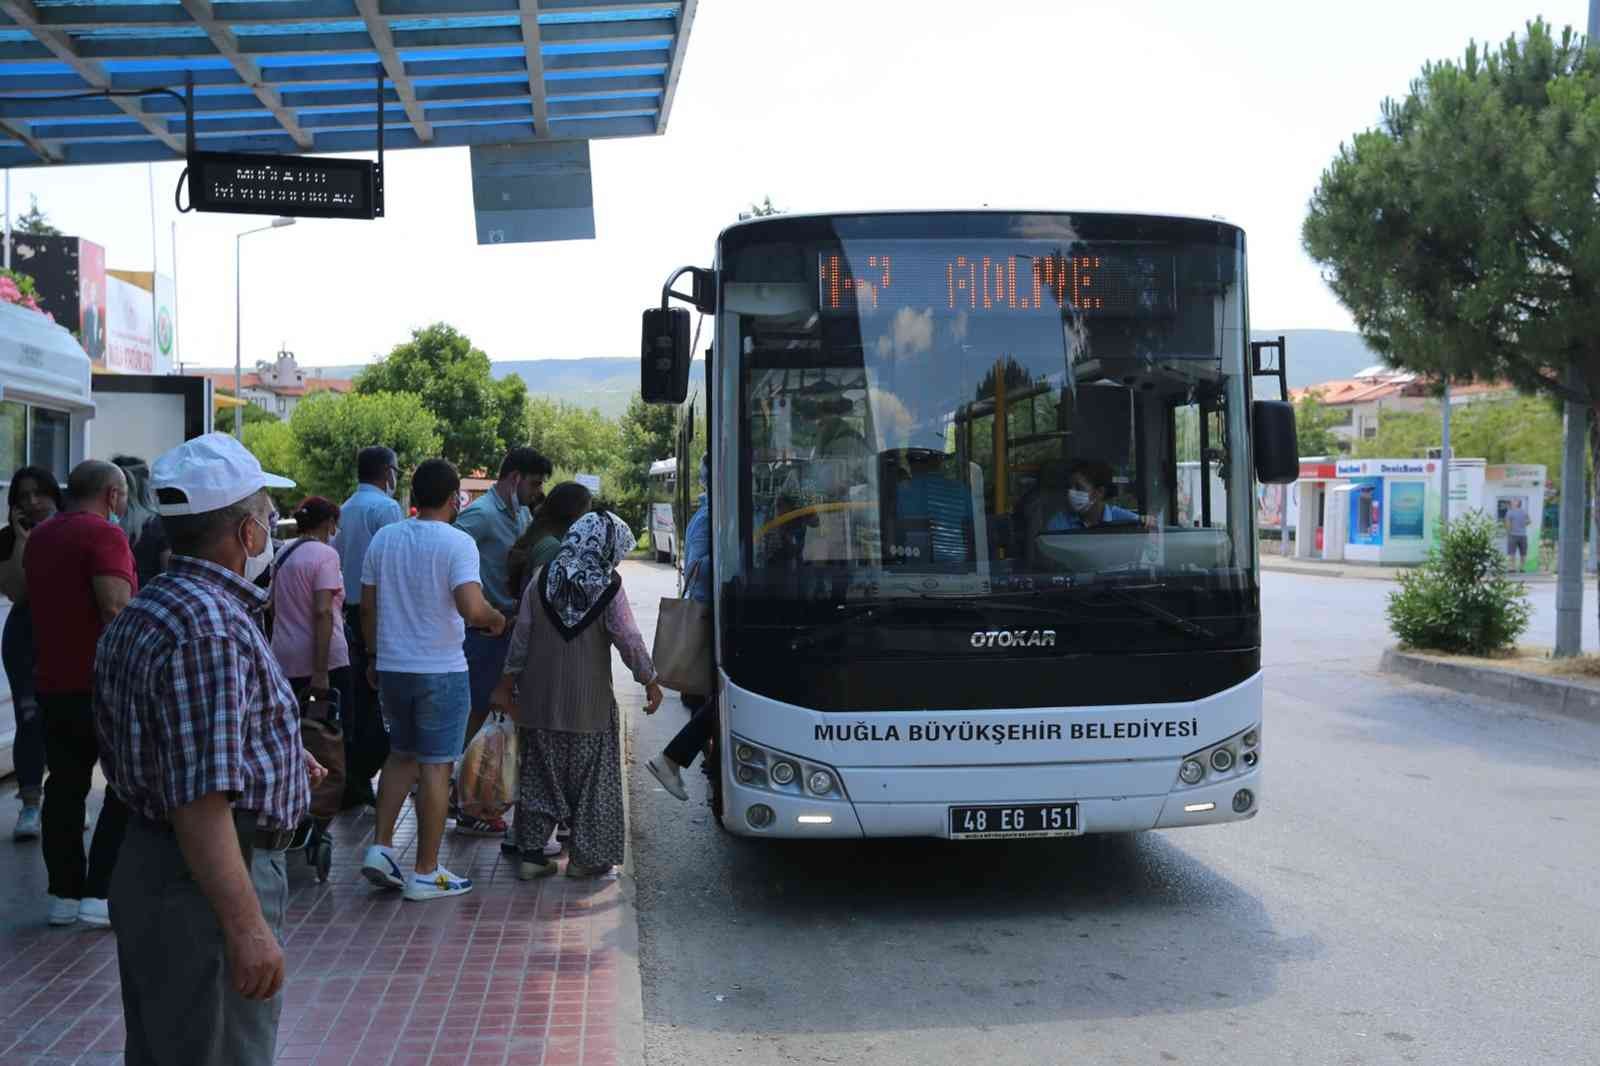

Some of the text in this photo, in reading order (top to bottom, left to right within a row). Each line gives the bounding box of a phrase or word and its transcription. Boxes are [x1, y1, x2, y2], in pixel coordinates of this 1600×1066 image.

[970, 630, 1056, 647] OTOKAR
[814, 717, 1198, 745] MUĞLA BÜYÜKŞEHİR BELEDİYESİ
[963, 807, 1072, 831] 48 EG 151
